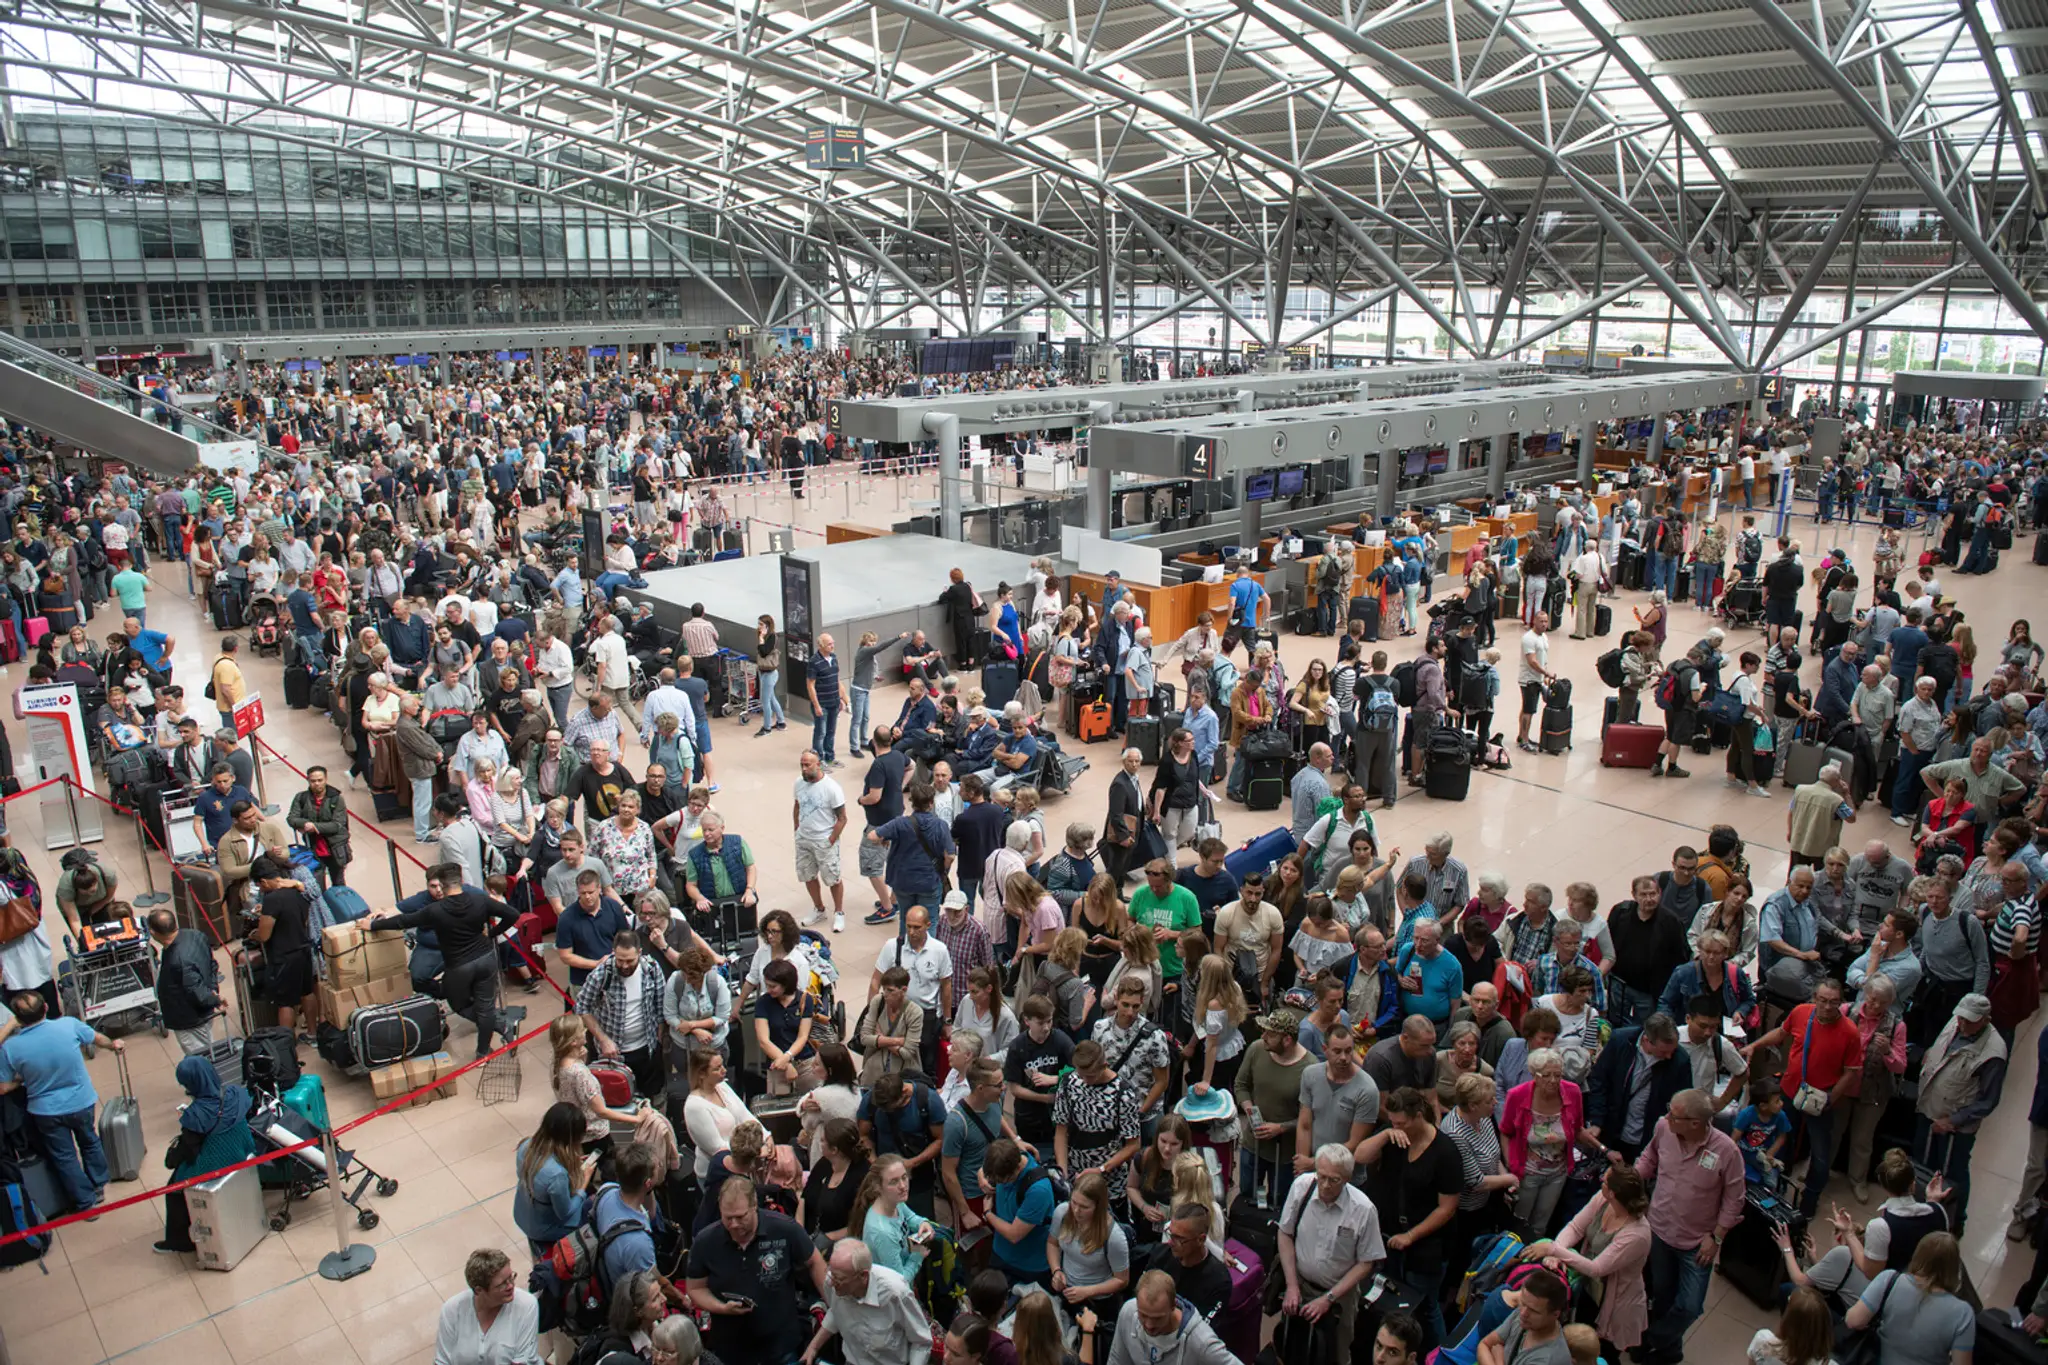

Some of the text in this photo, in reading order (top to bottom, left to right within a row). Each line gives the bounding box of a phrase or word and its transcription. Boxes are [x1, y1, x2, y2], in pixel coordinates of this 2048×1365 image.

[820, 144, 826, 162] 1
[851, 145, 858, 163] 1
[1765, 379, 1777, 393] 4
[830, 405, 839, 423] 3
[1194, 444, 1206, 466] 4
[1025, 1055, 1059, 1068] adidas
